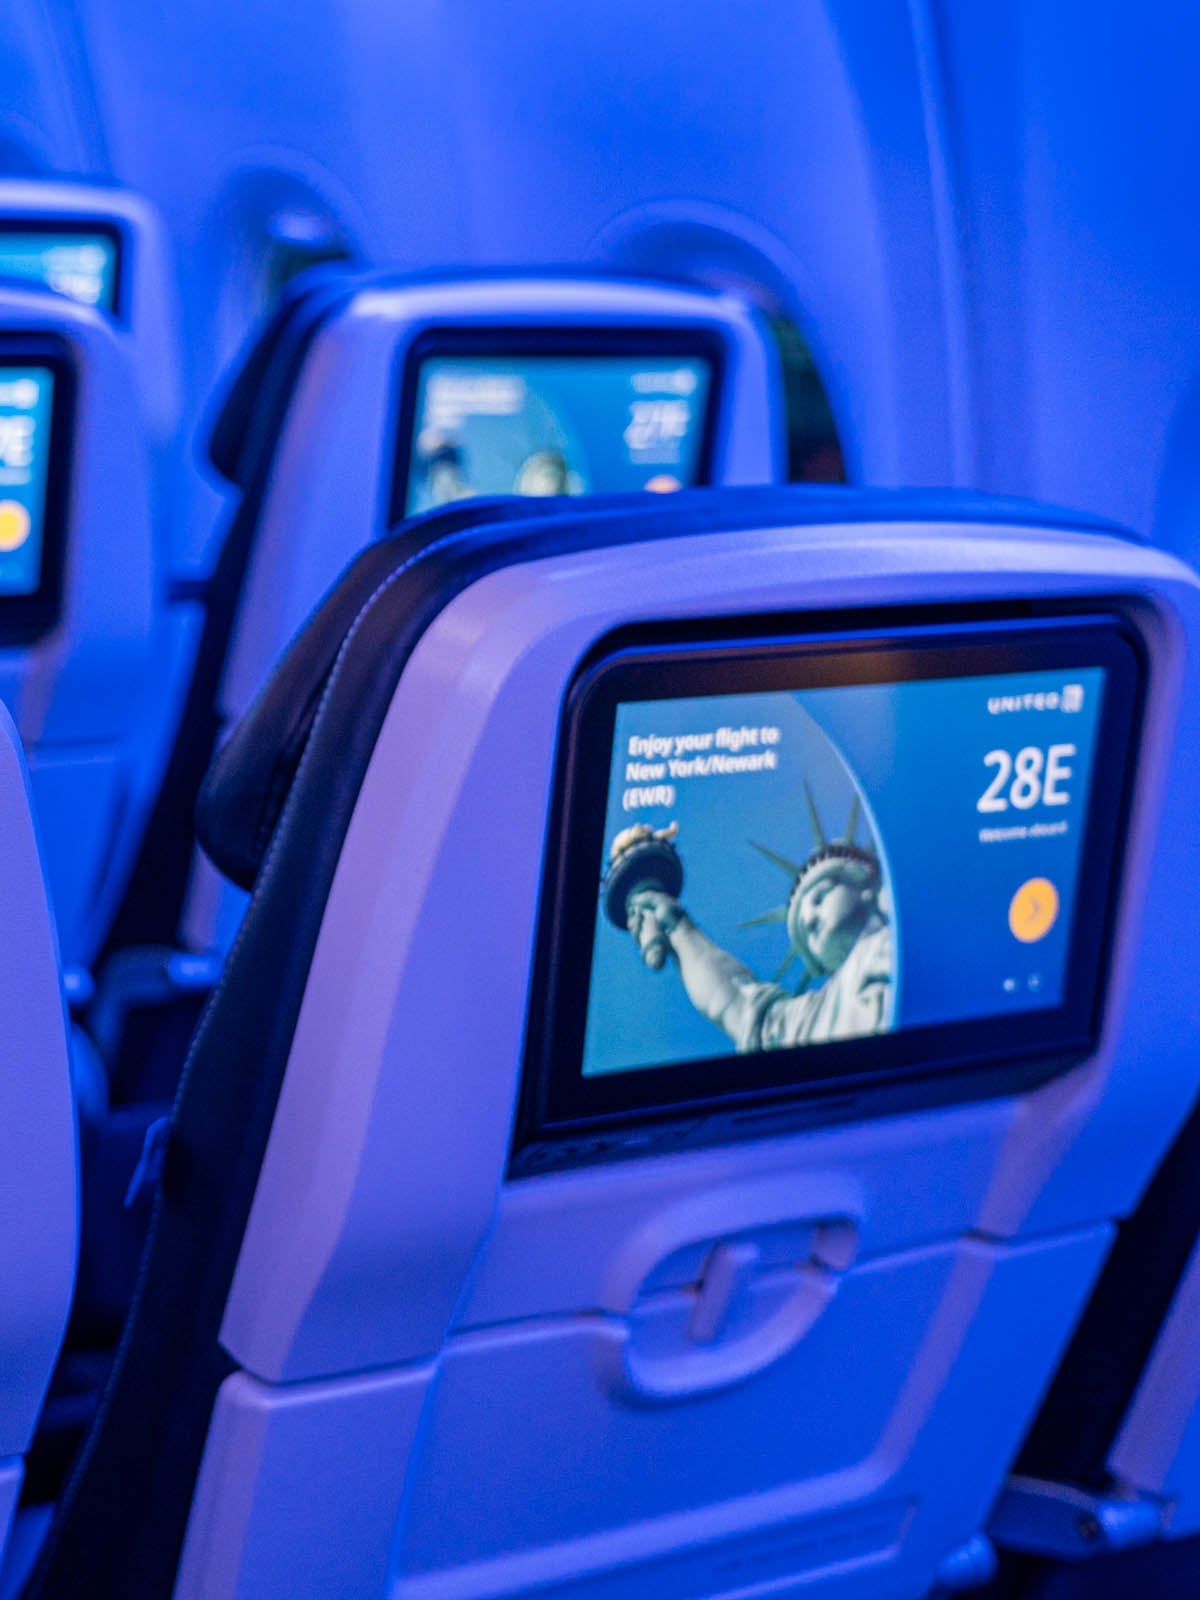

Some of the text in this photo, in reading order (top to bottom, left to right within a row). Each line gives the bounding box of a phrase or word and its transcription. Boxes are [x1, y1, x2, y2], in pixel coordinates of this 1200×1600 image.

[987, 691, 1060, 715] UNITED
[628, 726, 780, 759] Enjoy your flight to
[625, 750, 777, 781] New York/Newark
[977, 743, 1077, 813] 28E
[623, 785, 674, 811] (EWR)
